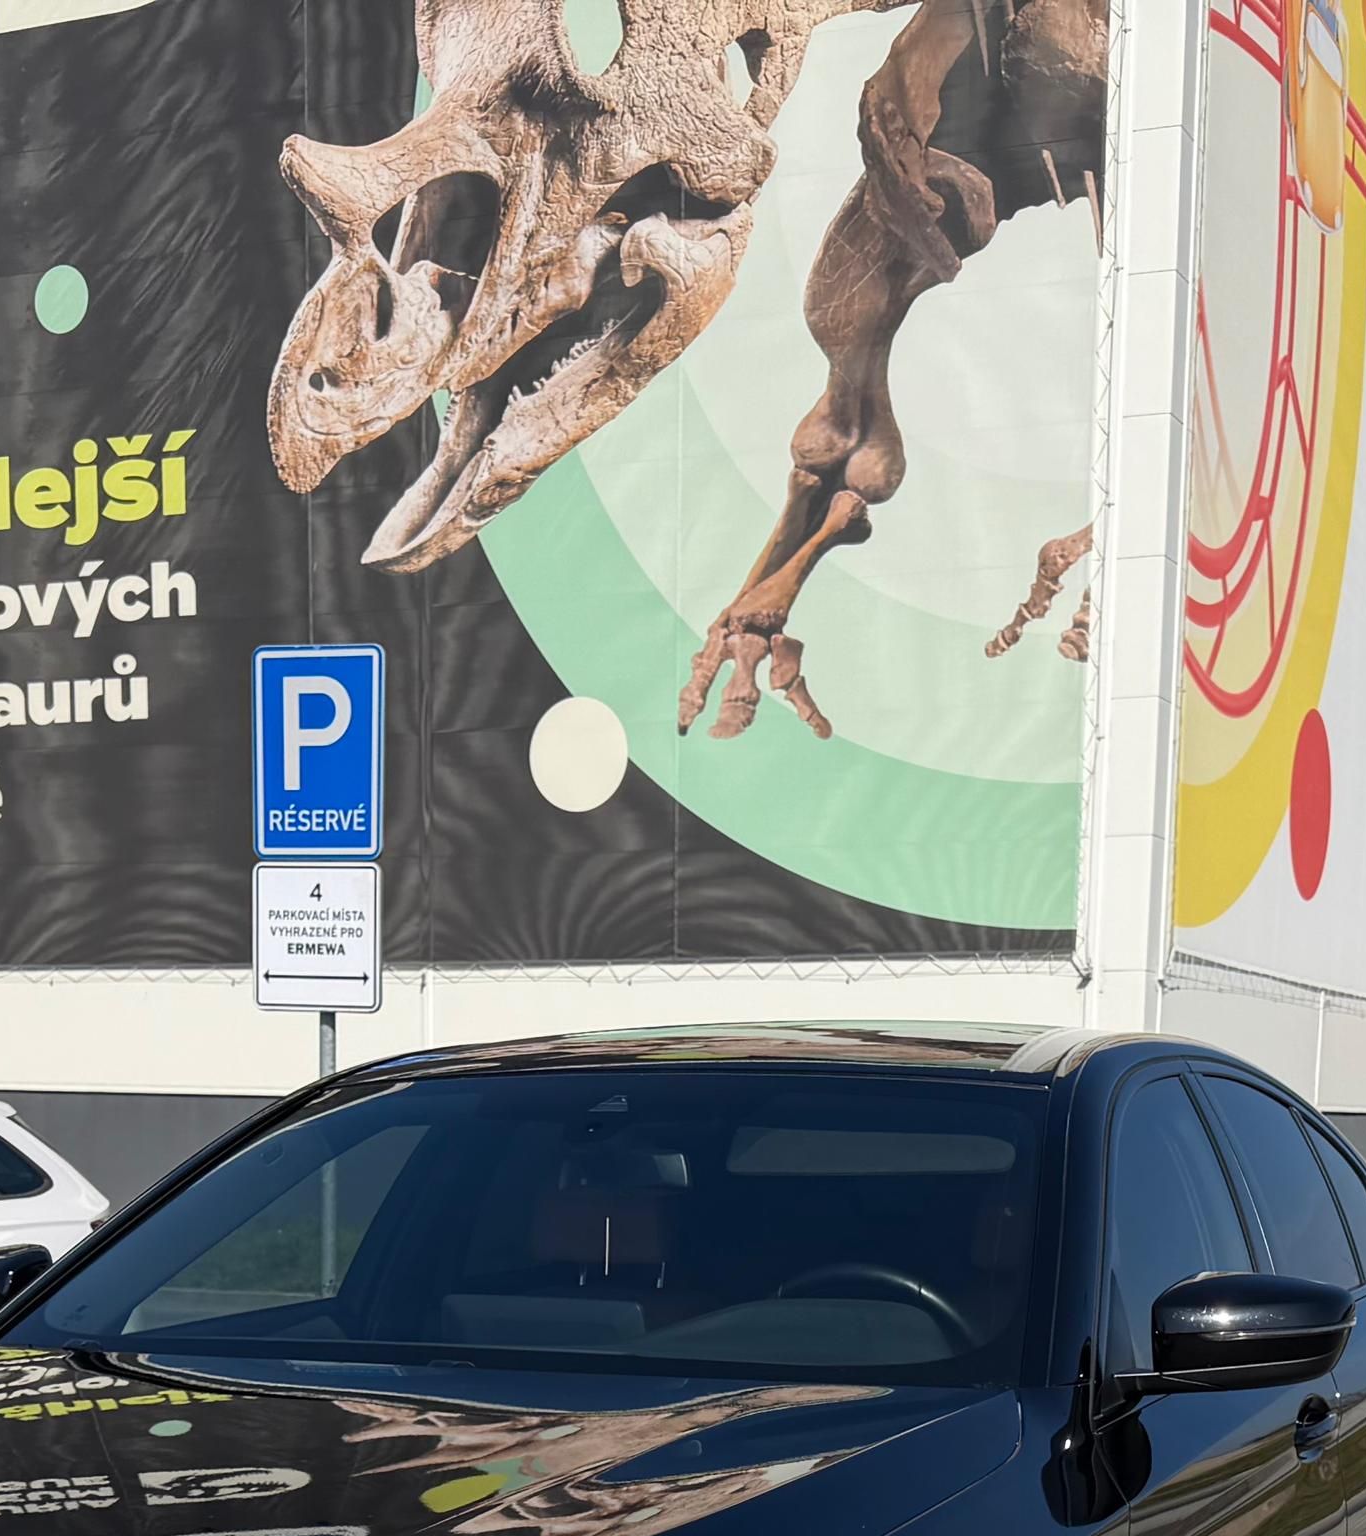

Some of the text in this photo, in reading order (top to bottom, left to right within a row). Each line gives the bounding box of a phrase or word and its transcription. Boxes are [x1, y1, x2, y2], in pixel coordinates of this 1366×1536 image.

[282, 675, 352, 791] P
[268, 803, 367, 832] RÉSERVÉ
[309, 883, 323, 902] 4
[268, 907, 366, 923] PARKOVACÍ MÍSTA
[270, 925, 364, 940] VYHRAZENÉ PRO
[286, 942, 346, 956] ERMEWA
